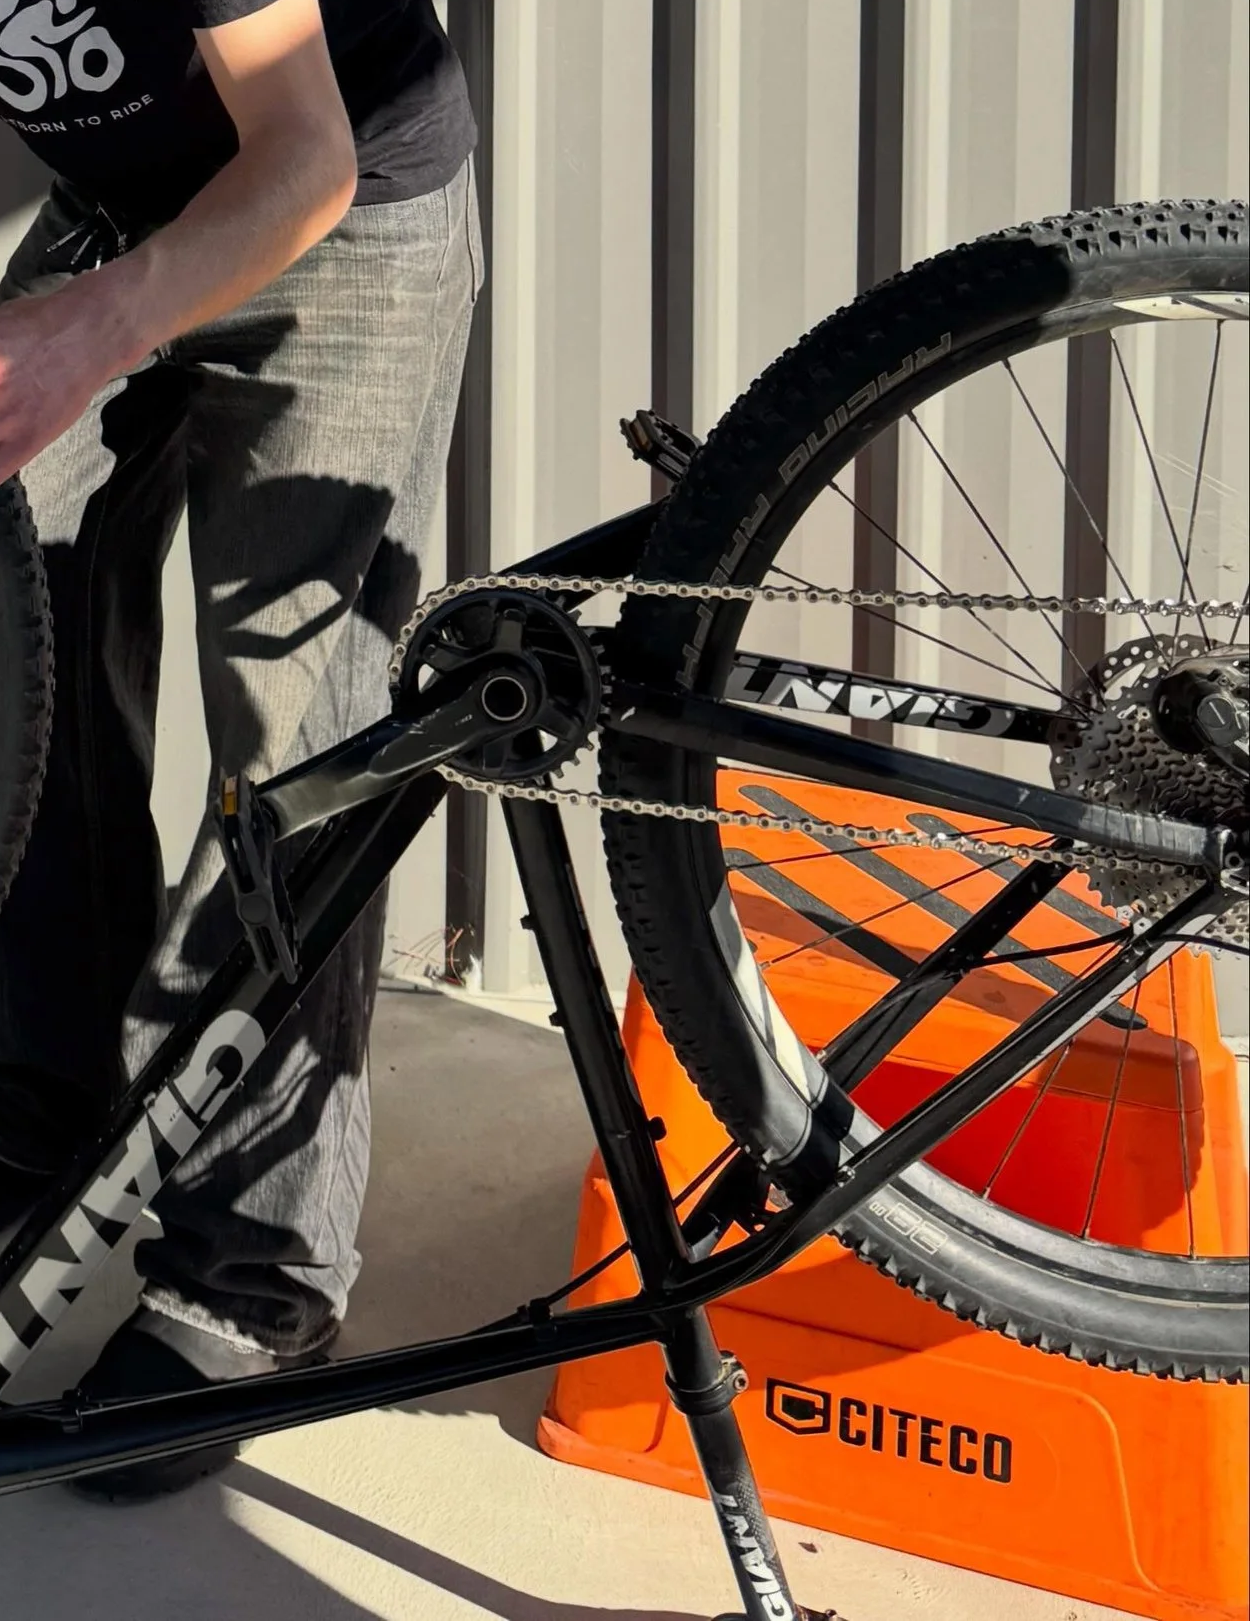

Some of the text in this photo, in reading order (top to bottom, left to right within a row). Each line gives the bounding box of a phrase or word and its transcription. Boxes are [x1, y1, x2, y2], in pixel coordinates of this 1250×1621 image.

[75, 115, 102, 129] TO
[110, 94, 154, 121] RIDE
[778, 332, 952, 488] RACING
[838, 1396, 1013, 1485] CITECO
